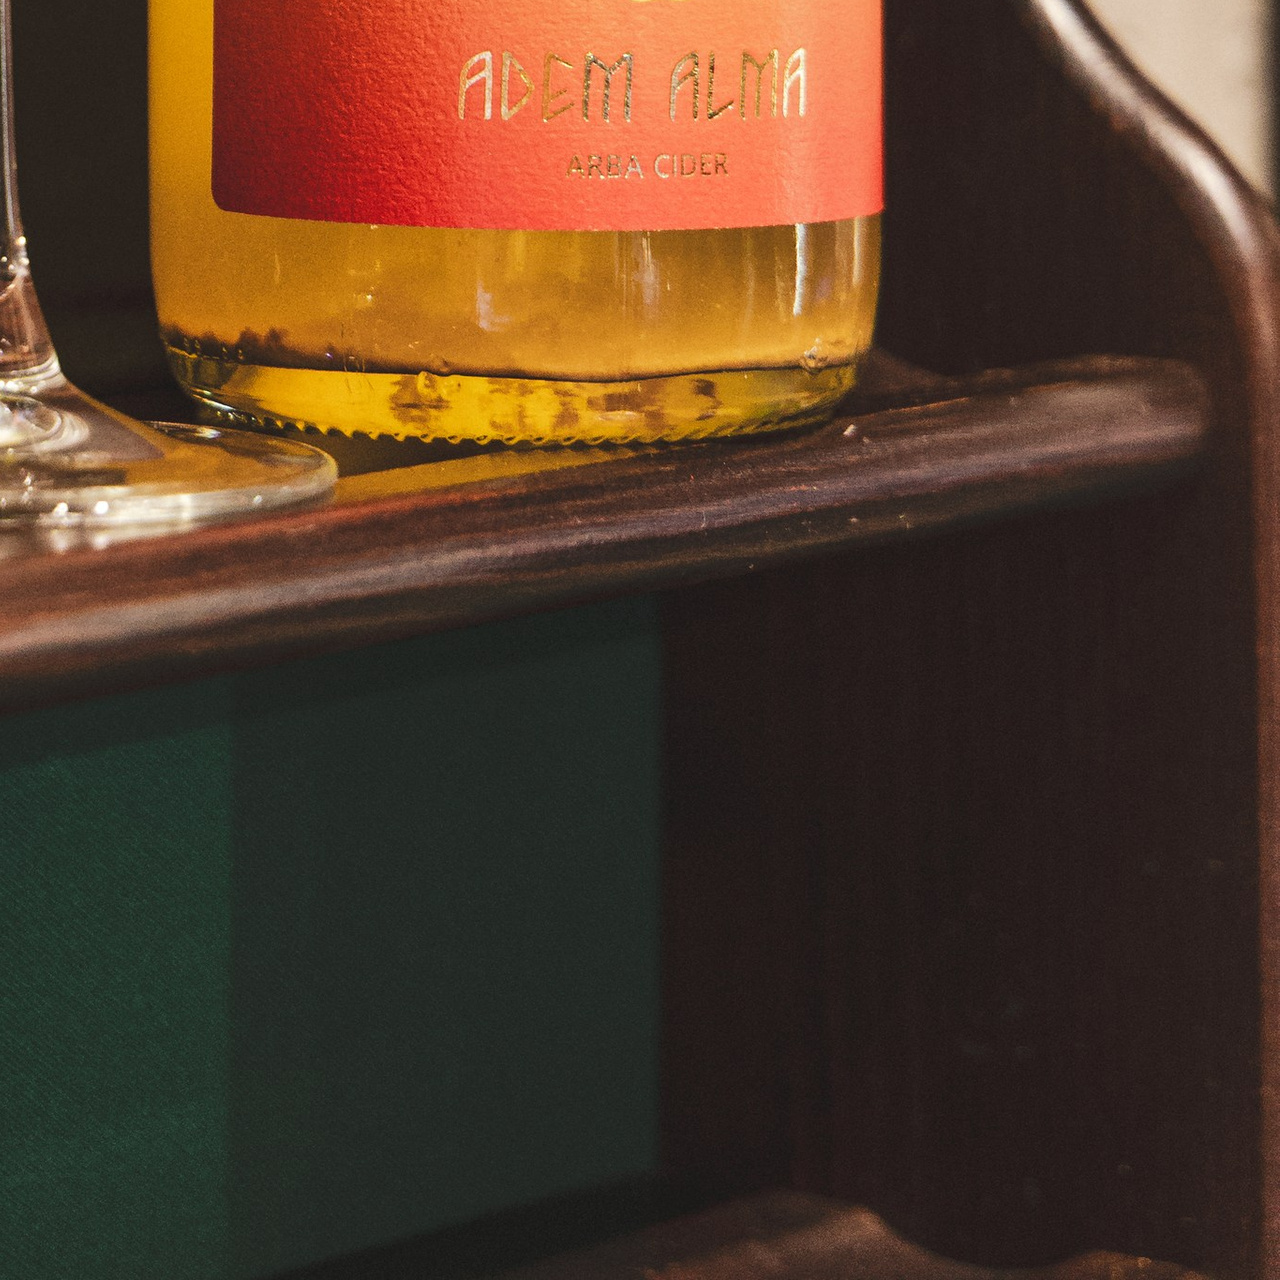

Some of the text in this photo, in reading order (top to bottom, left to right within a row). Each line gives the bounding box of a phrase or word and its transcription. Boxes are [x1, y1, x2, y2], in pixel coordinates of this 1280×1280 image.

[457, 47, 808, 123] ADEM ALMA
[566, 152, 729, 180] ARBA CIDER
